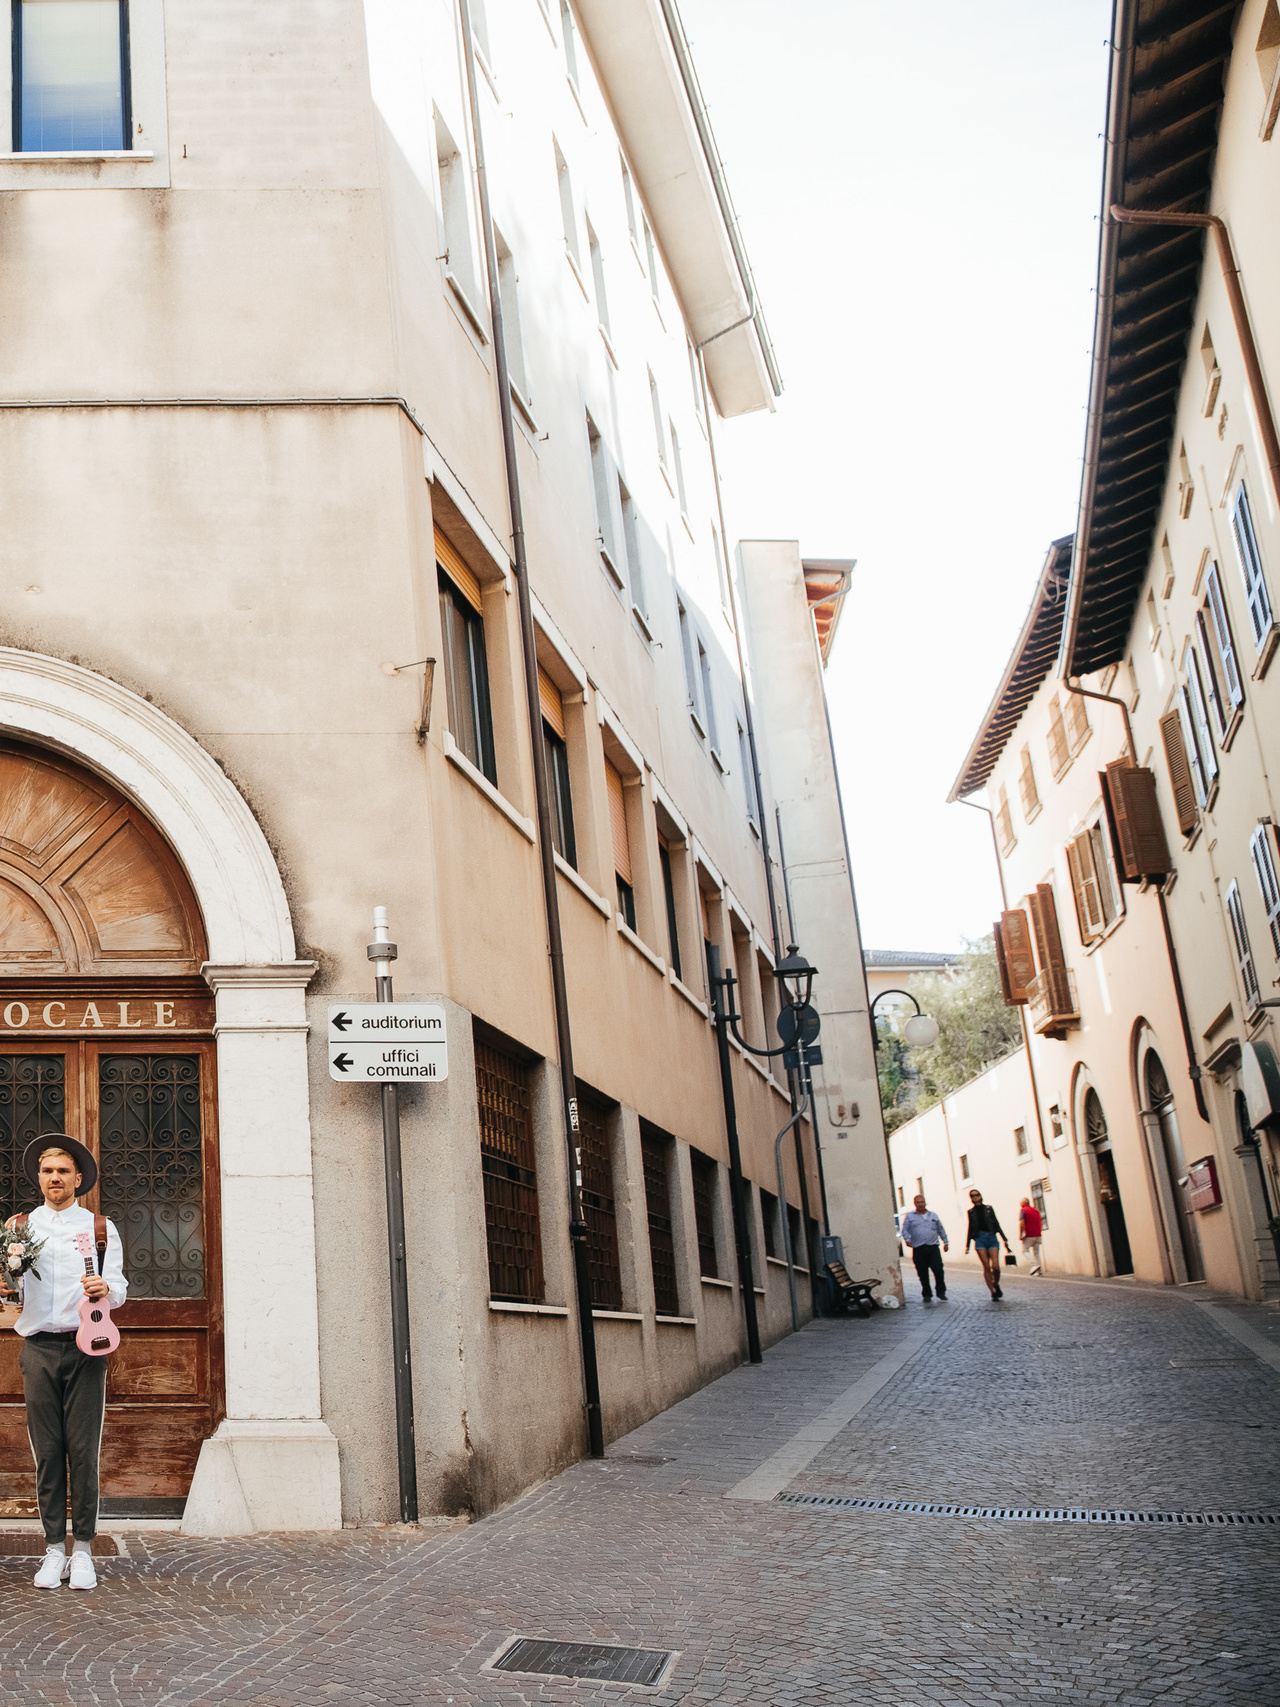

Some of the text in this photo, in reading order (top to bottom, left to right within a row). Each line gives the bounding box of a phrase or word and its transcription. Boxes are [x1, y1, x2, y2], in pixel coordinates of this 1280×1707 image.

[361, 1015, 442, 1029] auditorium
[382, 1049, 419, 1062] uffici
[366, 1063, 436, 1076] comunali
